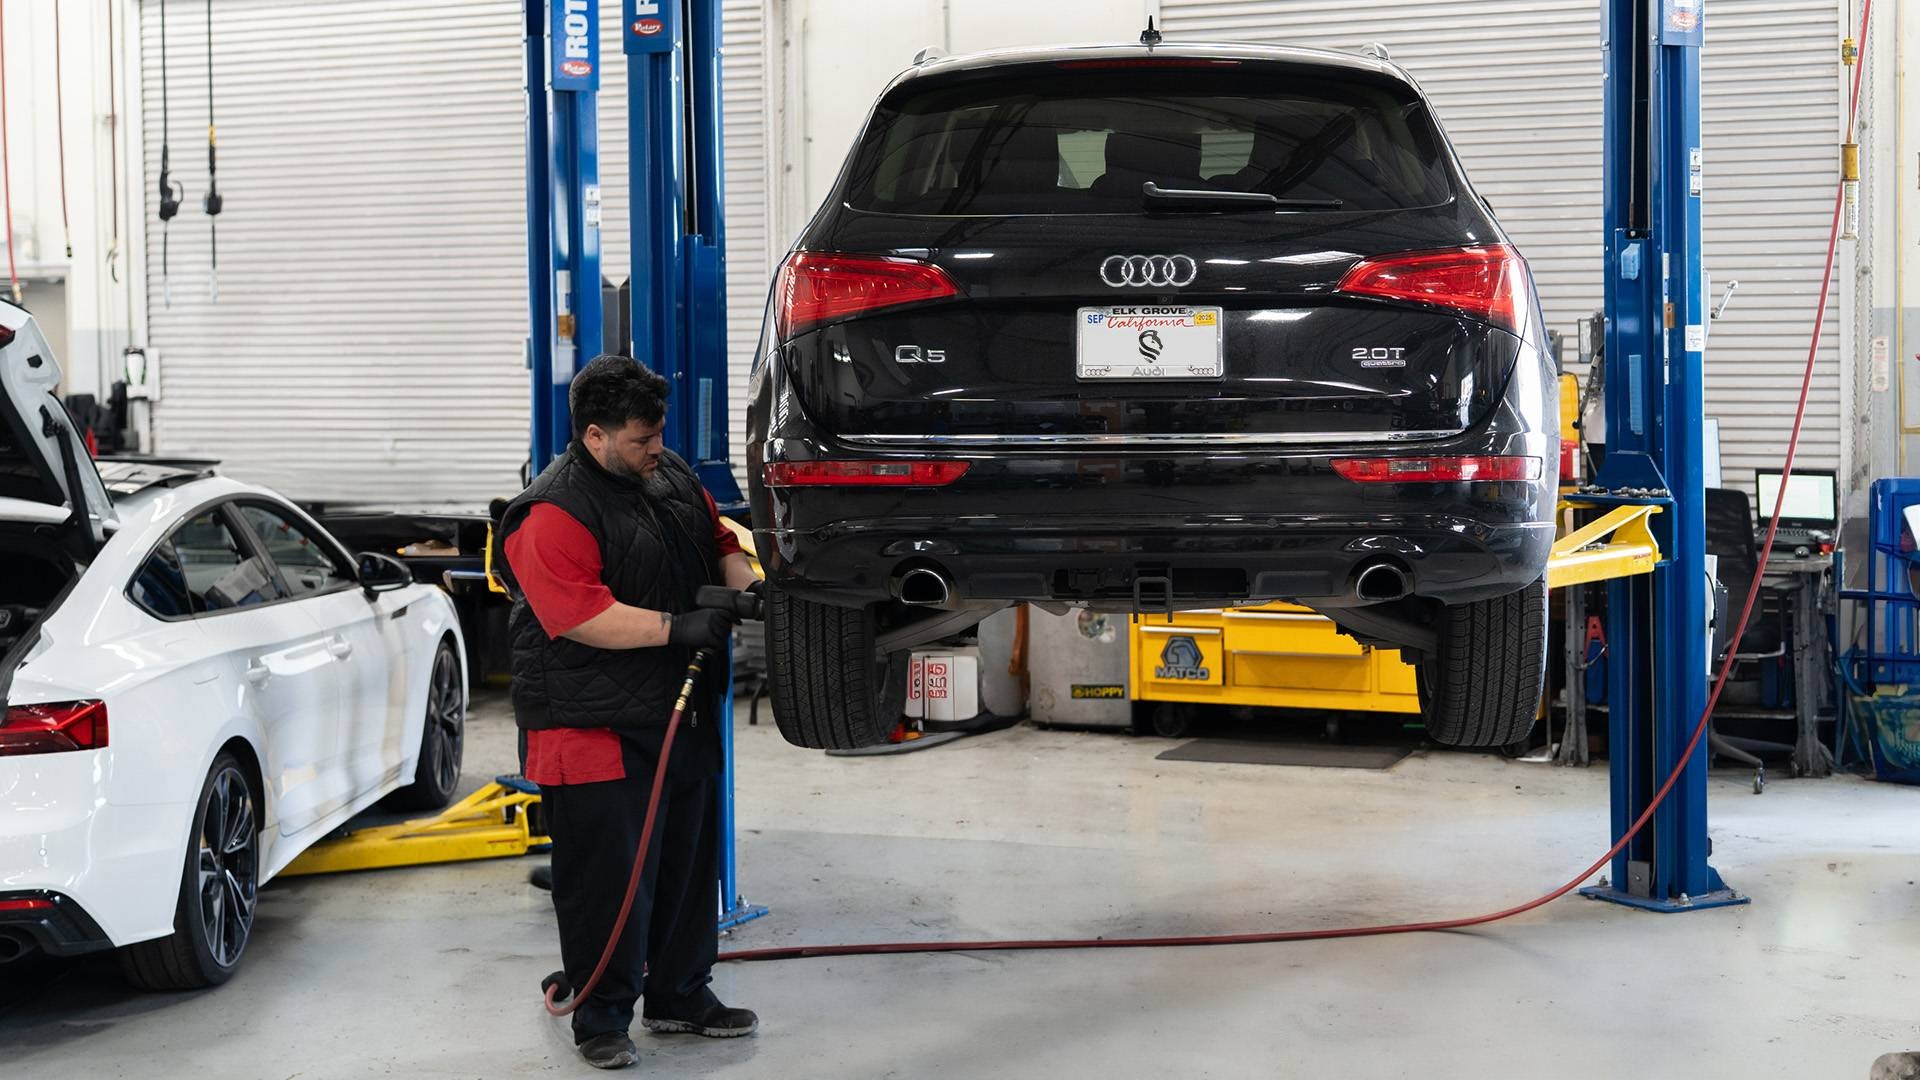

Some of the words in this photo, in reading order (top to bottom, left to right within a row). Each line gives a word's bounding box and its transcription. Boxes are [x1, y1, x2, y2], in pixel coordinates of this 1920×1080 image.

[1112, 307, 1137, 315] ELK
[1141, 307, 1186, 315] GROVE
[1087, 314, 1104, 324] SEP
[1107, 316, 1194, 331] California
[895, 344, 946, 363] Q5
[1351, 347, 1406, 360] 2.0T
[1132, 366, 1167, 376] Audi
[1154, 666, 1210, 681] MATCO
[1085, 687, 1124, 698] HOPPY
